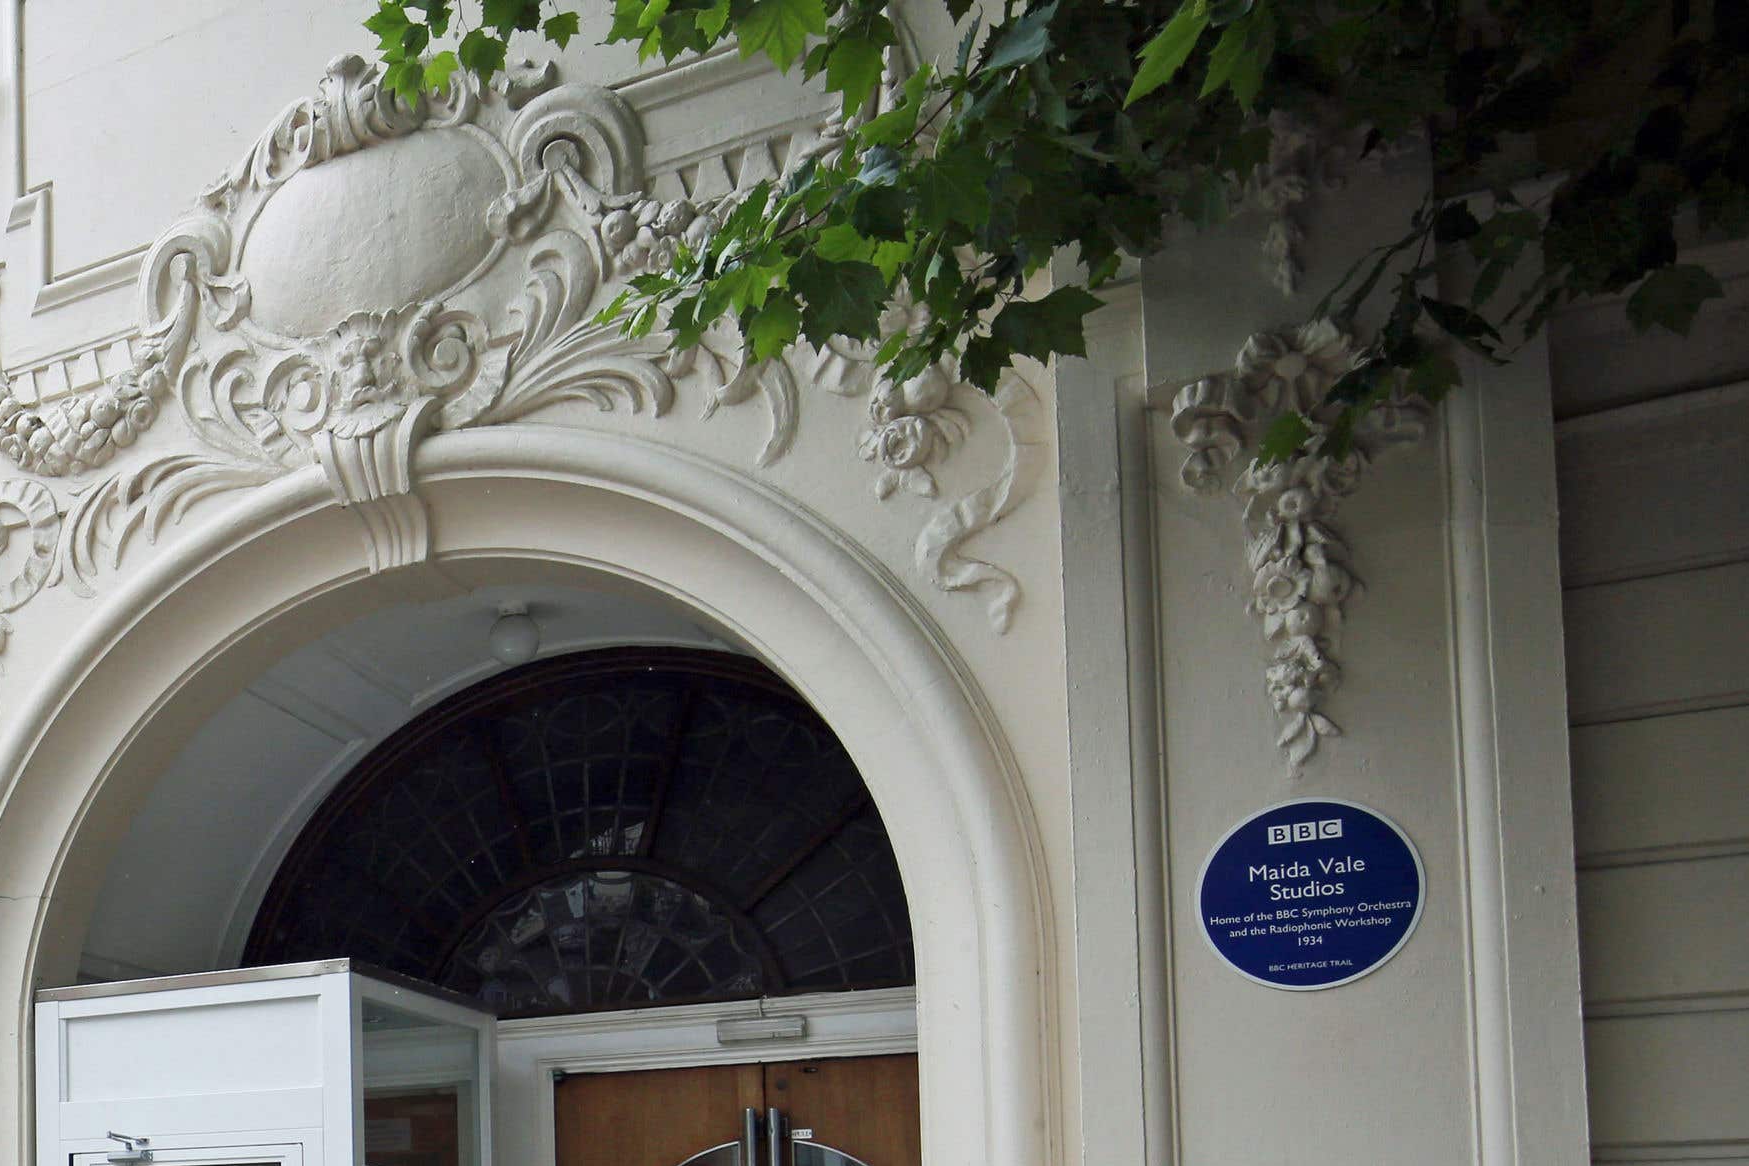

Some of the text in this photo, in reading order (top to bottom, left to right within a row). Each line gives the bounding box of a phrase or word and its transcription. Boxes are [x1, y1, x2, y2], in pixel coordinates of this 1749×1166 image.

[1271, 820, 1341, 843] BBC
[1250, 856, 1365, 882] Maida Vale
[1270, 881, 1345, 900] Studios
[1210, 901, 1411, 925] Home of the BBC Symphony Orchestra
[1230, 916, 1392, 937] and the Radiophonic Workshop
[1298, 936, 1323, 946] 1934
[1269, 964, 1285, 972] BBC
[1287, 961, 1327, 970] HERITAGE
